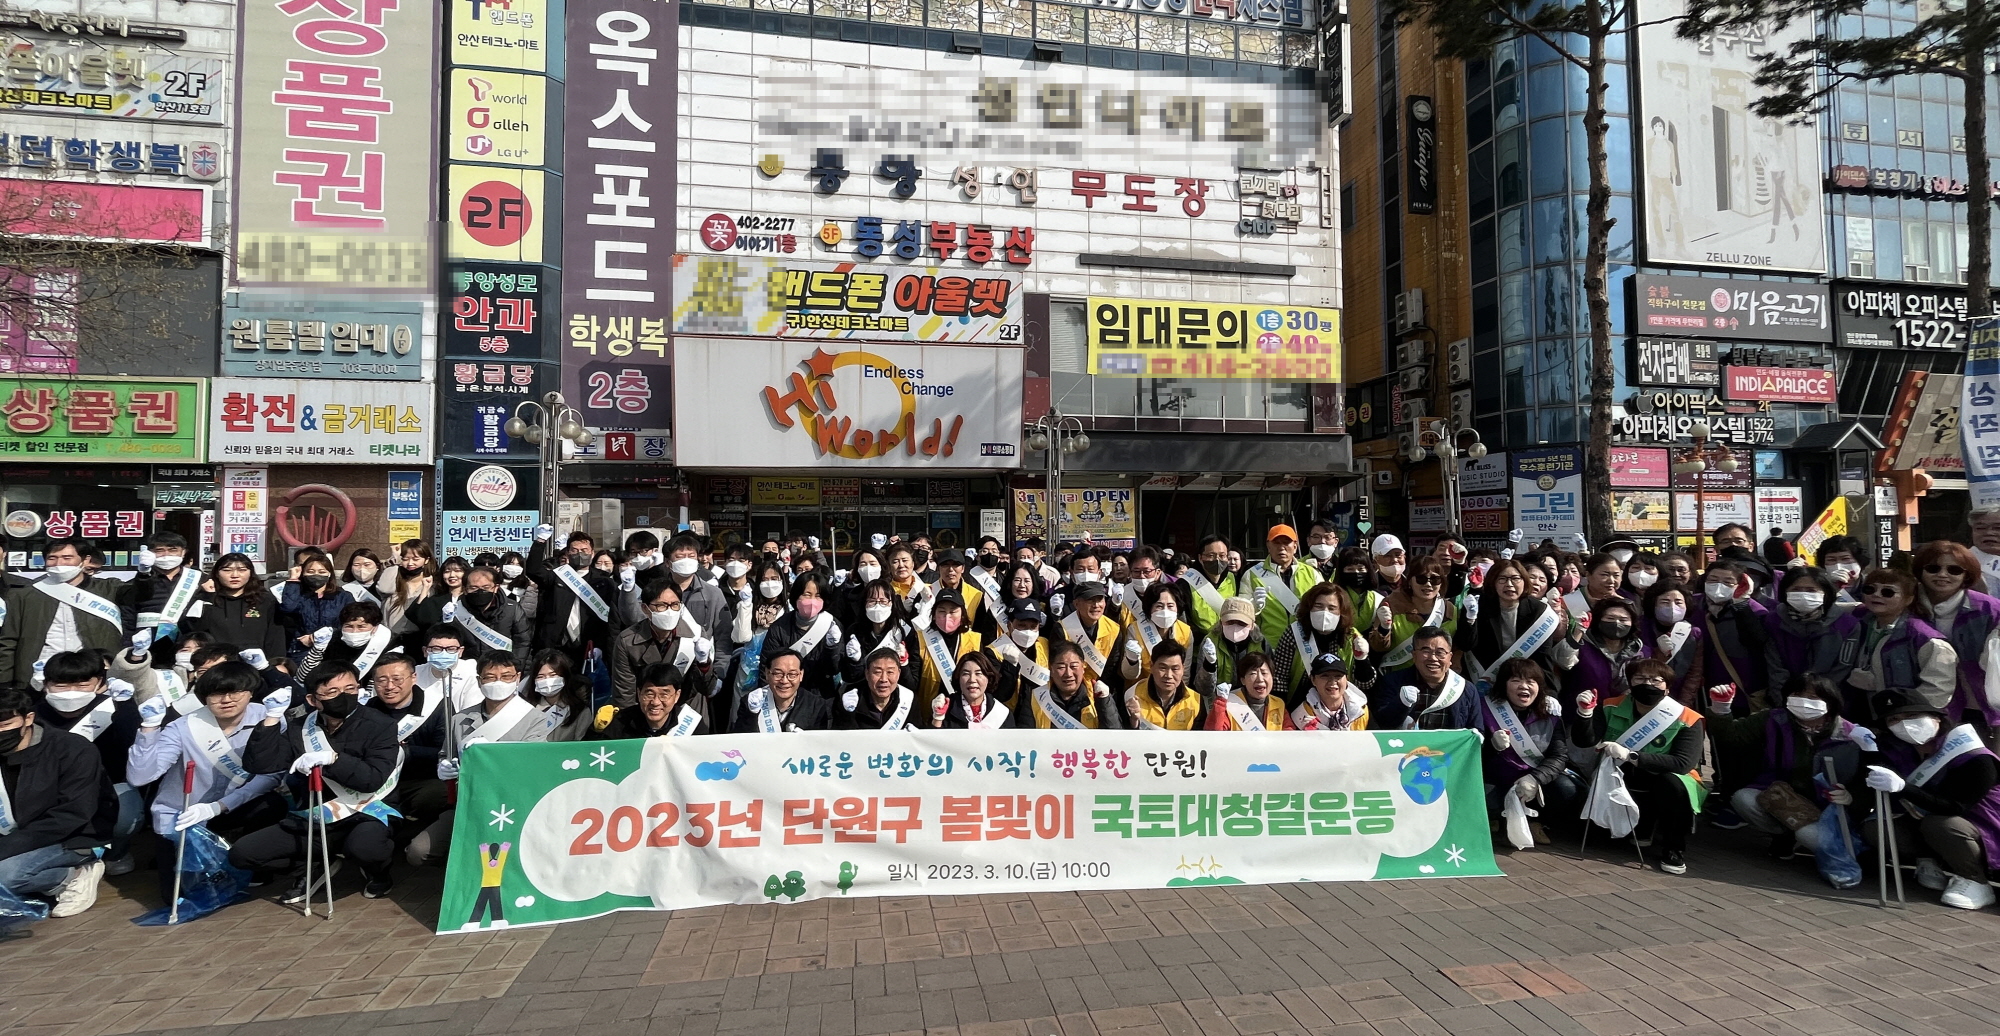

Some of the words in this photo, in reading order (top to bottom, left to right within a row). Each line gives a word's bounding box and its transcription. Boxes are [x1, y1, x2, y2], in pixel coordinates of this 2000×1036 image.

[164, 71, 207, 97] 2F
[492, 93, 527, 105] world
[493, 121, 529, 132] olleh
[497, 148, 512, 157] LG
[515, 149, 529, 158] U+
[585, 10, 658, 302] 옥스포드
[1875, 171, 1917, 188] 보청기
[1071, 170, 1210, 217] 무도장
[467, 196, 523, 229] 2F
[706, 220, 730, 246] 꽃
[736, 215, 795, 231] 402-2277
[822, 228, 839, 240] 5F
[1240, 218, 1277, 235] Club
[1706, 252, 1740, 263] ZELLU
[1743, 254, 1772, 266] ZONE
[893, 276, 1011, 318] 아울렛
[1682, 300, 1706, 311] 전문점
[1847, 289, 1901, 317] 아피체
[454, 296, 536, 333] 안과
[1733, 289, 1828, 330] 마음고기
[1096, 303, 1247, 352] 임대문의
[1260, 312, 1281, 329] 1층
[229, 319, 327, 351] 원룸텔
[331, 322, 388, 353] 임대
[569, 314, 669, 358] 학생복
[999, 324, 1021, 341] 2F
[479, 336, 509, 353] 5층
[1639, 341, 1690, 384] 전자담배
[454, 363, 534, 385] 황금당
[864, 365, 924, 379] Endless
[588, 369, 652, 414] 2층
[764, 350, 838, 428] Hi
[901, 381, 954, 399] Change
[3, 388, 179, 434] 상품권
[1361, 406, 1370, 419] 권
[1654, 393, 1725, 416] 아이픽스
[1758, 401, 1772, 412] 2F
[483, 414, 499, 448] 황금당
[1747, 418, 1774, 430] 1522
[817, 411, 964, 458] World!
[1748, 431, 1775, 443] 3774
[25, 441, 49, 452] 할인
[53, 441, 89, 453] 전문점
[224, 445, 251, 455] 신뢰와
[255, 445, 282, 455] 믿음의
[286, 445, 303, 456] 국내
[307, 446, 325, 456] 최대
[328, 446, 355, 456] 거래소
[369, 444, 421, 457] 티켓나라
[642, 437, 667, 457] 장
[173, 469, 189, 477] 최대
[1480, 470, 1506, 479] STUDIO
[1519, 461, 1574, 472] 우수훈련기관
[757, 482, 773, 491] 안산
[929, 480, 964, 496] 황금당
[392, 491, 418, 501] 부동산
[1082, 490, 1130, 502] OPEN
[1521, 492, 1575, 513] 그린
[1360, 496, 1369, 520] 그린
[44, 511, 145, 538] 상품권
[451, 515, 467, 523] 난청
[471, 515, 487, 523] 이명
[1464, 514, 1502, 529] 상품권
[1538, 523, 1558, 531] 안산
[1759, 513, 1783, 524] 홍보관
[1784, 513, 1801, 524] 입구
[448, 527, 535, 542] 연세난청센터
[782, 753, 854, 780] 새로운
[867, 751, 954, 778] 변화의
[967, 750, 1038, 780] 시작!
[1051, 749, 1132, 780] 행복한
[1144, 749, 1208, 779] 단원!
[569, 799, 764, 857] 2023년
[782, 795, 923, 845] 단원구
[938, 792, 1074, 842] 봄맞이
[1091, 789, 1398, 838] 국토대청결운동
[887, 863, 919, 882] 일시
[927, 863, 979, 881] 2023.
[983, 863, 1001, 880] 3.
[1061, 861, 1111, 878] 10:00
